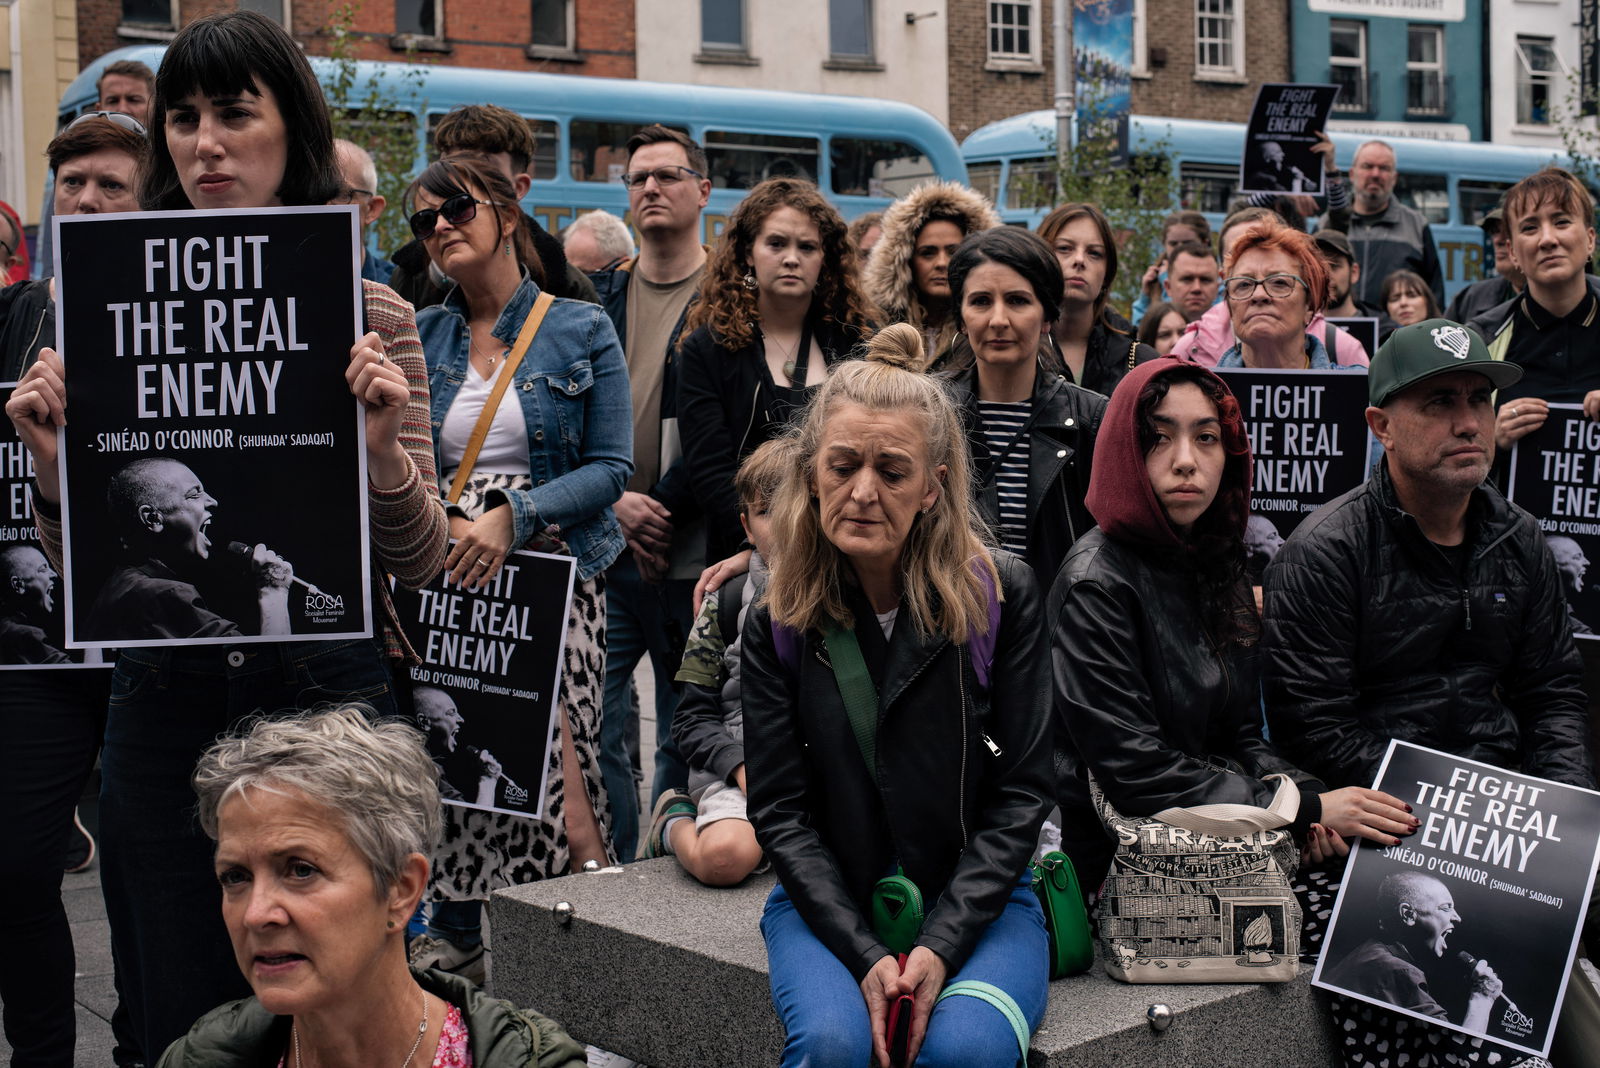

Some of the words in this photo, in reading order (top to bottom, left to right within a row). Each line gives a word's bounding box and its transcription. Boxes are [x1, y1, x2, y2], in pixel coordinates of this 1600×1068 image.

[1266, 102, 1288, 116] THE
[1289, 104, 1318, 117] REAL
[1280, 89, 1316, 103] FIGHT
[1267, 117, 1308, 132] ENEMY
[144, 235, 269, 293] FIGHT
[107, 300, 186, 357] THE
[203, 296, 309, 353] REAL
[137, 360, 283, 418] ENEMY
[1250, 385, 1326, 419] FIGHT
[97, 428, 150, 452] SINÉAD
[155, 429, 234, 451] O'CONNOR
[239, 434, 288, 450] (SHUHADA'
[290, 432, 334, 447] SADAQAT)
[1245, 422, 1274, 455] HE
[1283, 423, 1343, 456] REAL
[1251, 459, 1329, 493] NEMY
[1541, 450, 1586, 483] THE
[1251, 497, 1298, 512] O'CONNOR
[1552, 485, 1600, 519] ENE
[305, 595, 344, 609] ROSA
[418, 589, 463, 630] THE
[470, 598, 533, 641] REAL
[425, 630, 516, 676] ENEMY
[432, 671, 480, 691] O'CONNOR
[512, 688, 539, 701] SADAQAT)
[1449, 767, 1546, 807] FIGHT
[1416, 781, 1475, 817] THE
[1483, 799, 1561, 842] REAL
[1420, 812, 1539, 873] ENEMY
[1127, 852, 1151, 866] NEW
[1152, 859, 1180, 872] YORK
[1184, 864, 1207, 873] CITY
[1383, 846, 1425, 867] SINÉAD
[1427, 856, 1488, 886] O'CONNOR
[1489, 878, 1528, 897] (SHUHADA'
[1529, 889, 1563, 909] SADAQAT)
[1503, 1010, 1534, 1029] ROSA
